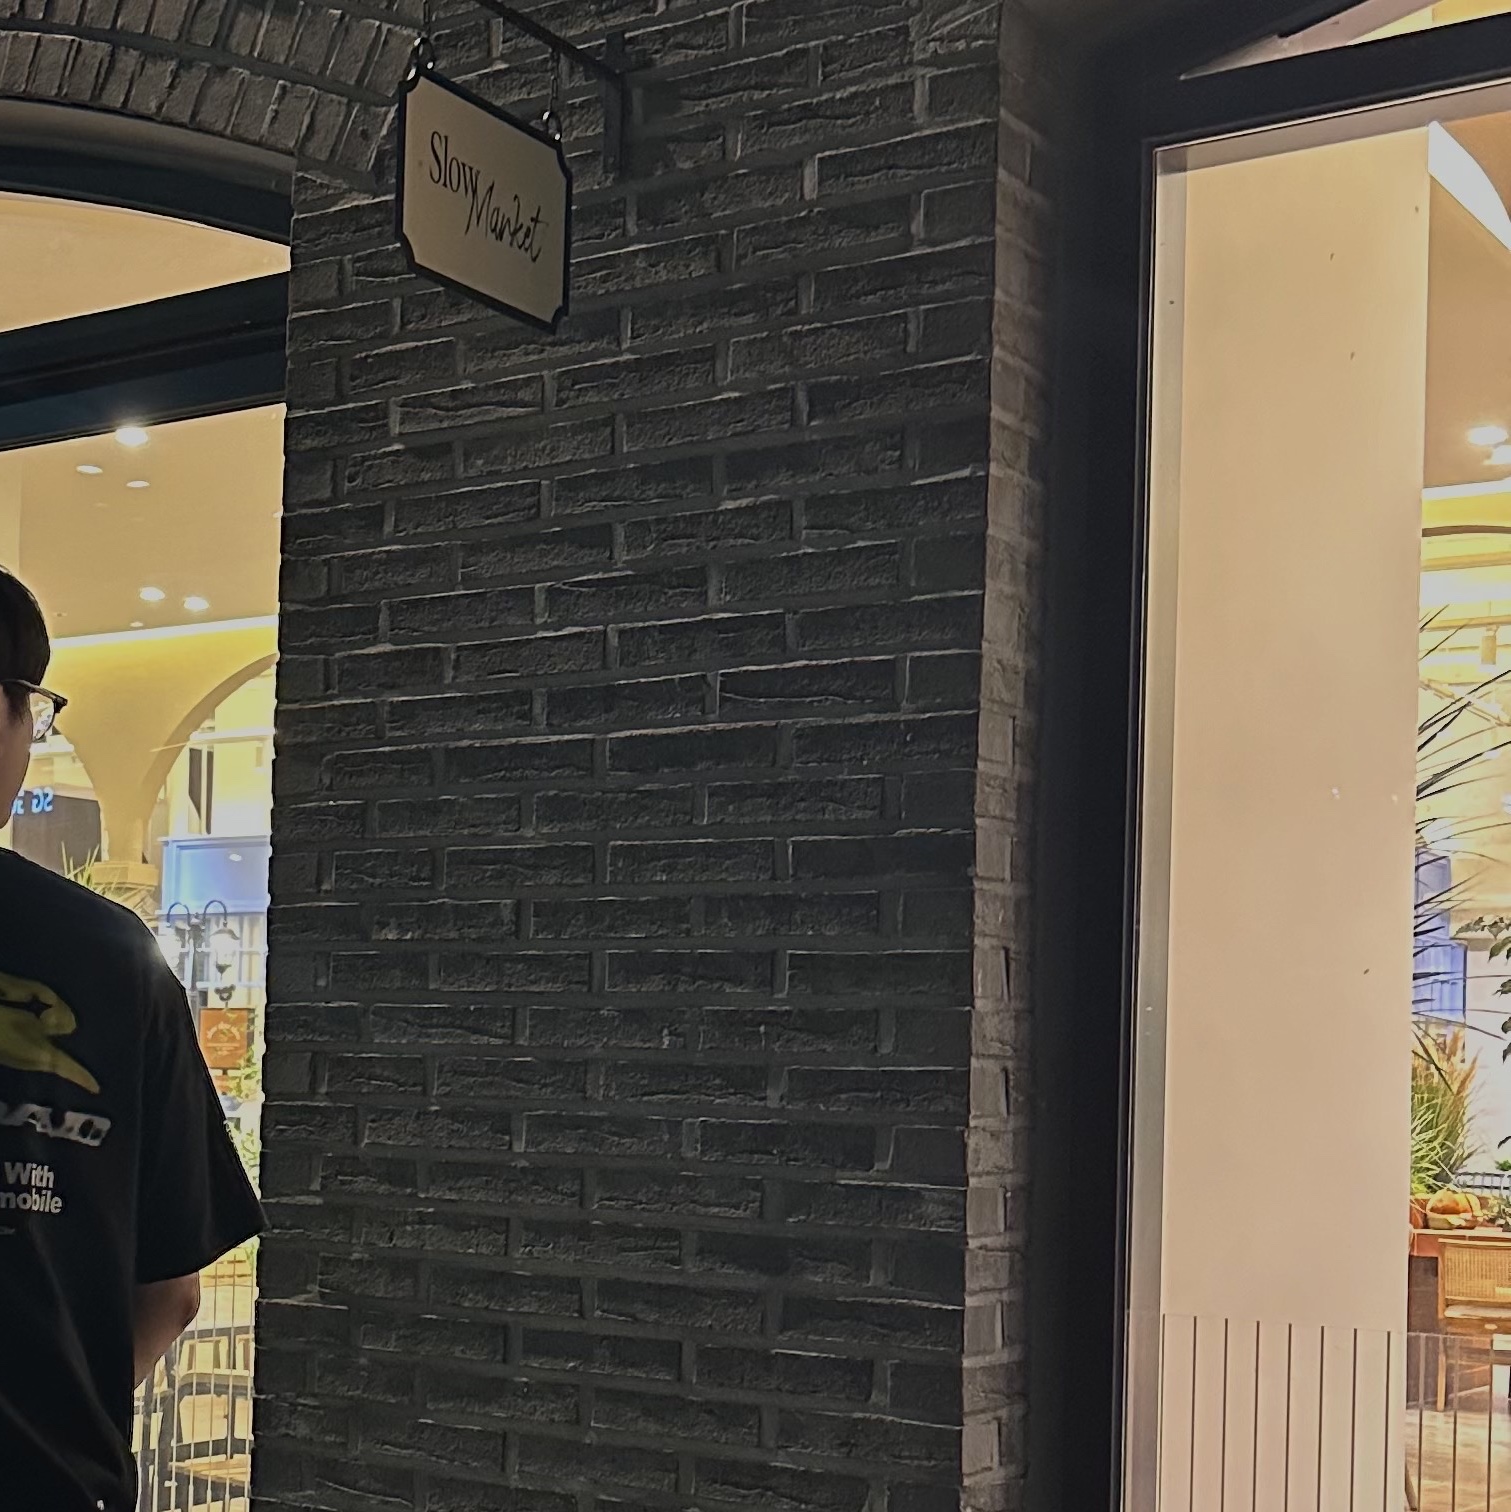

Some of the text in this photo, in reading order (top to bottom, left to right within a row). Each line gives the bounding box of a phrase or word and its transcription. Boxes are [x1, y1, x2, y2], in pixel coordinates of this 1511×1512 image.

[430, 131, 548, 262] Slow Market
[4, 1161, 55, 1190] With
